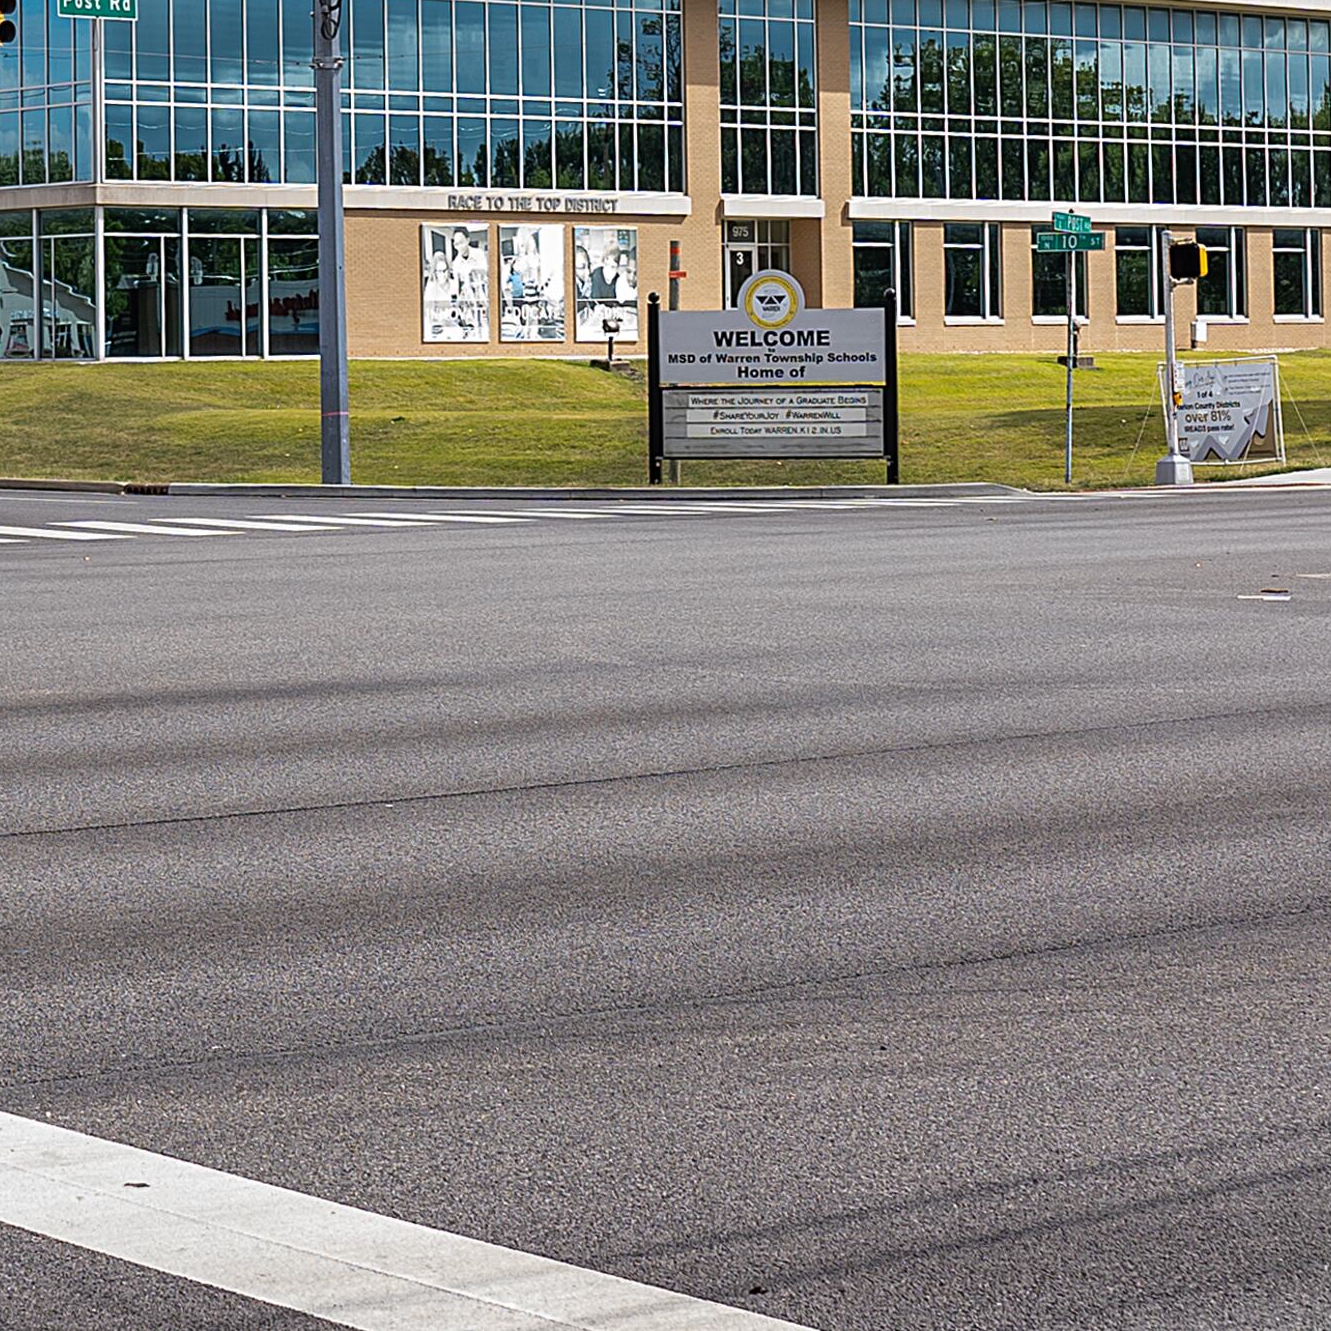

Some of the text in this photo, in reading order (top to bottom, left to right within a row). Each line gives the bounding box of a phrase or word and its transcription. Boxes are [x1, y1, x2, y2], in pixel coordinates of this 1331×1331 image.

[447, 194, 618, 212] RACE TO THE TOP DISTRICT
[732, 226, 749, 237] 975
[736, 252, 744, 265] 3
[713, 330, 831, 347] WELCOME
[668, 352, 878, 365] MSD of Warren Township Schools
[737, 366, 806, 379] Home of
[1194, 401, 1215, 410] County
[1184, 410, 1231, 423] over 81%
